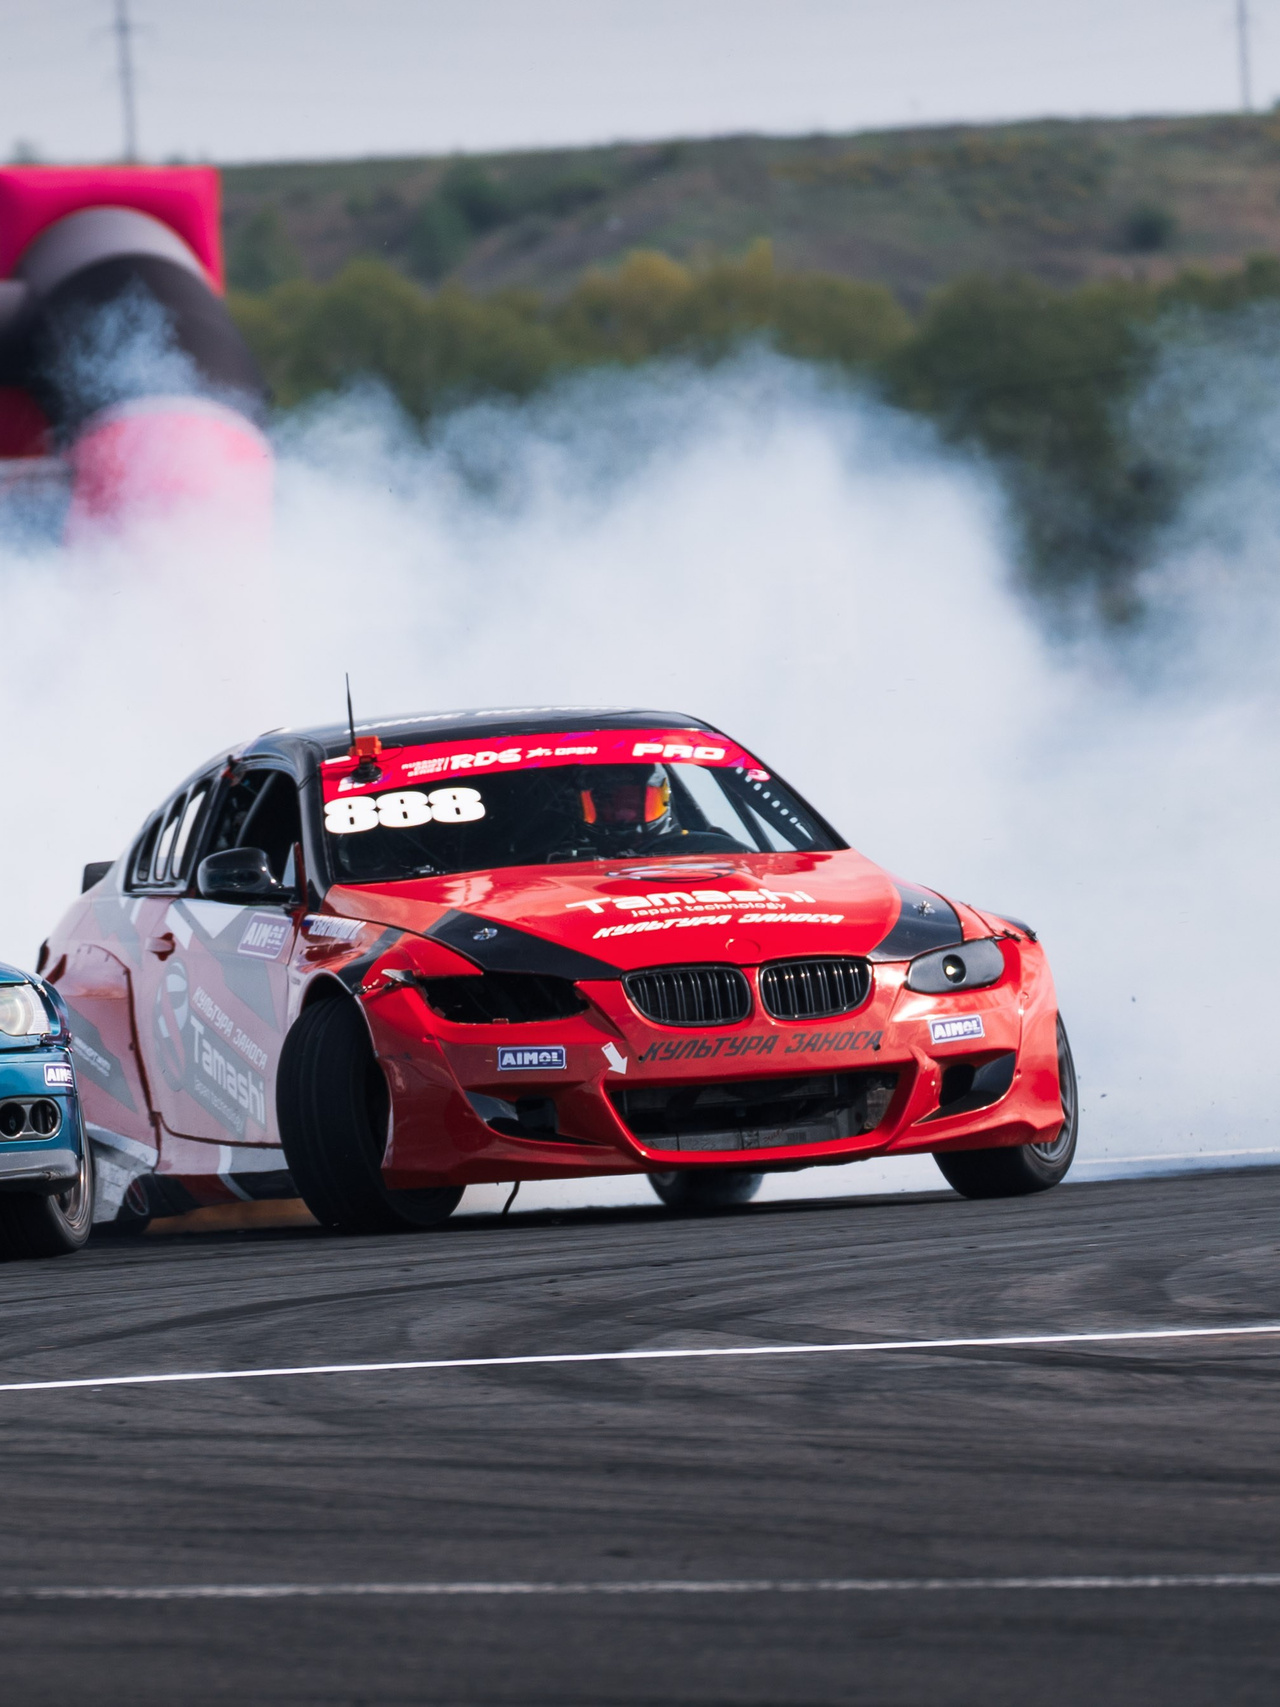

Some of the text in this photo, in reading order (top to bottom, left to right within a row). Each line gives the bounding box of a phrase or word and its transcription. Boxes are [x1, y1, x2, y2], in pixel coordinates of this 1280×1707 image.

[554, 746, 598, 756] OPEN
[631, 742, 725, 760] PRO
[324, 787, 486, 834] 888
[565, 889, 816, 914] Tamashi
[684, 900, 787, 913] technology
[592, 912, 845, 940] КУЛЬТУРА ЗАНОСА
[192, 986, 269, 1070] КУЛЬТУРА ЗАНОСА
[933, 1021, 982, 1040] AIMOL
[643, 1030, 883, 1062] КУЛЬТУРА ЗАНОСА
[190, 1015, 265, 1124] Tamashi
[502, 1052, 562, 1066] AIMOL
